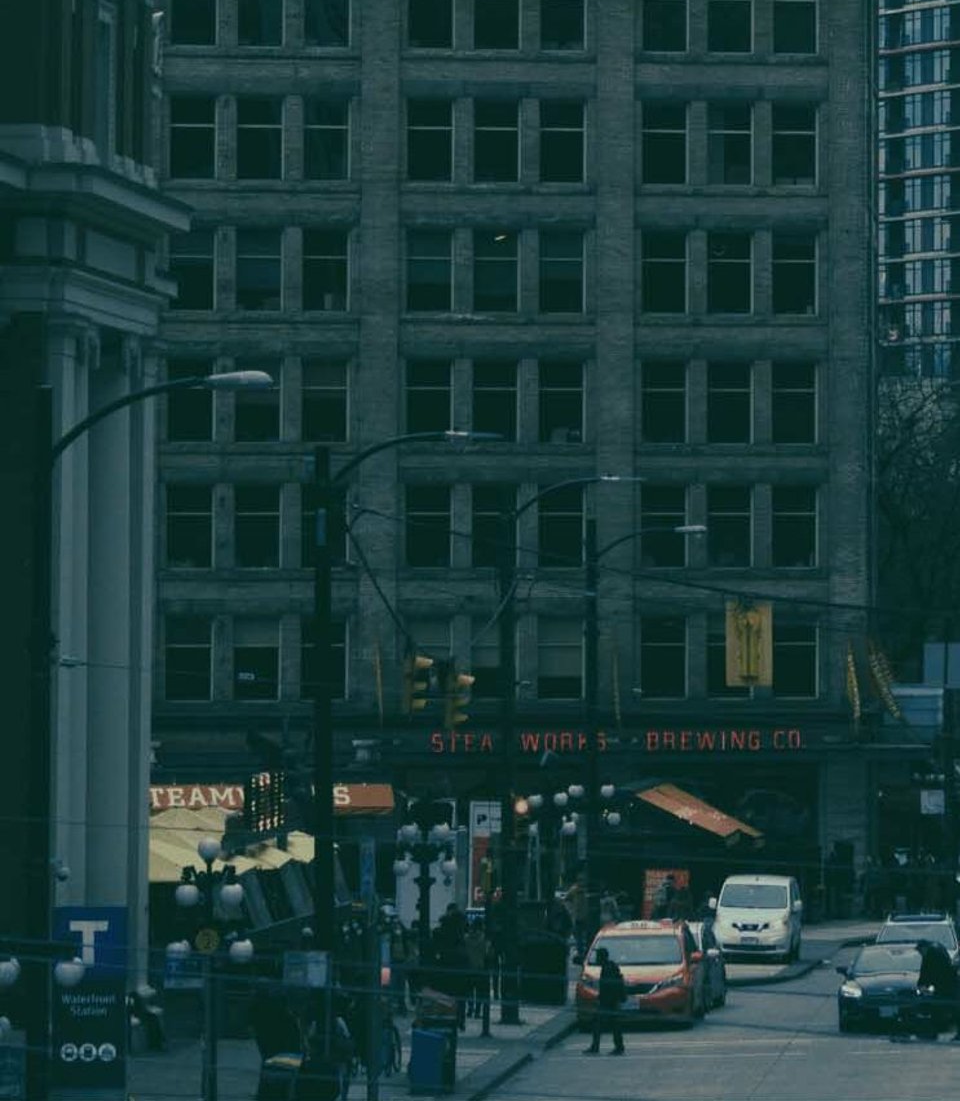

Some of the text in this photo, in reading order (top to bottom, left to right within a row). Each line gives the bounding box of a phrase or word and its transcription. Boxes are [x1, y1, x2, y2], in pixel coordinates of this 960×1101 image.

[646, 730, 761, 751] BREWING
[69, 920, 109, 967] T
[62, 994, 115, 1005] Waterfront
[71, 1005, 107, 1017] Station
